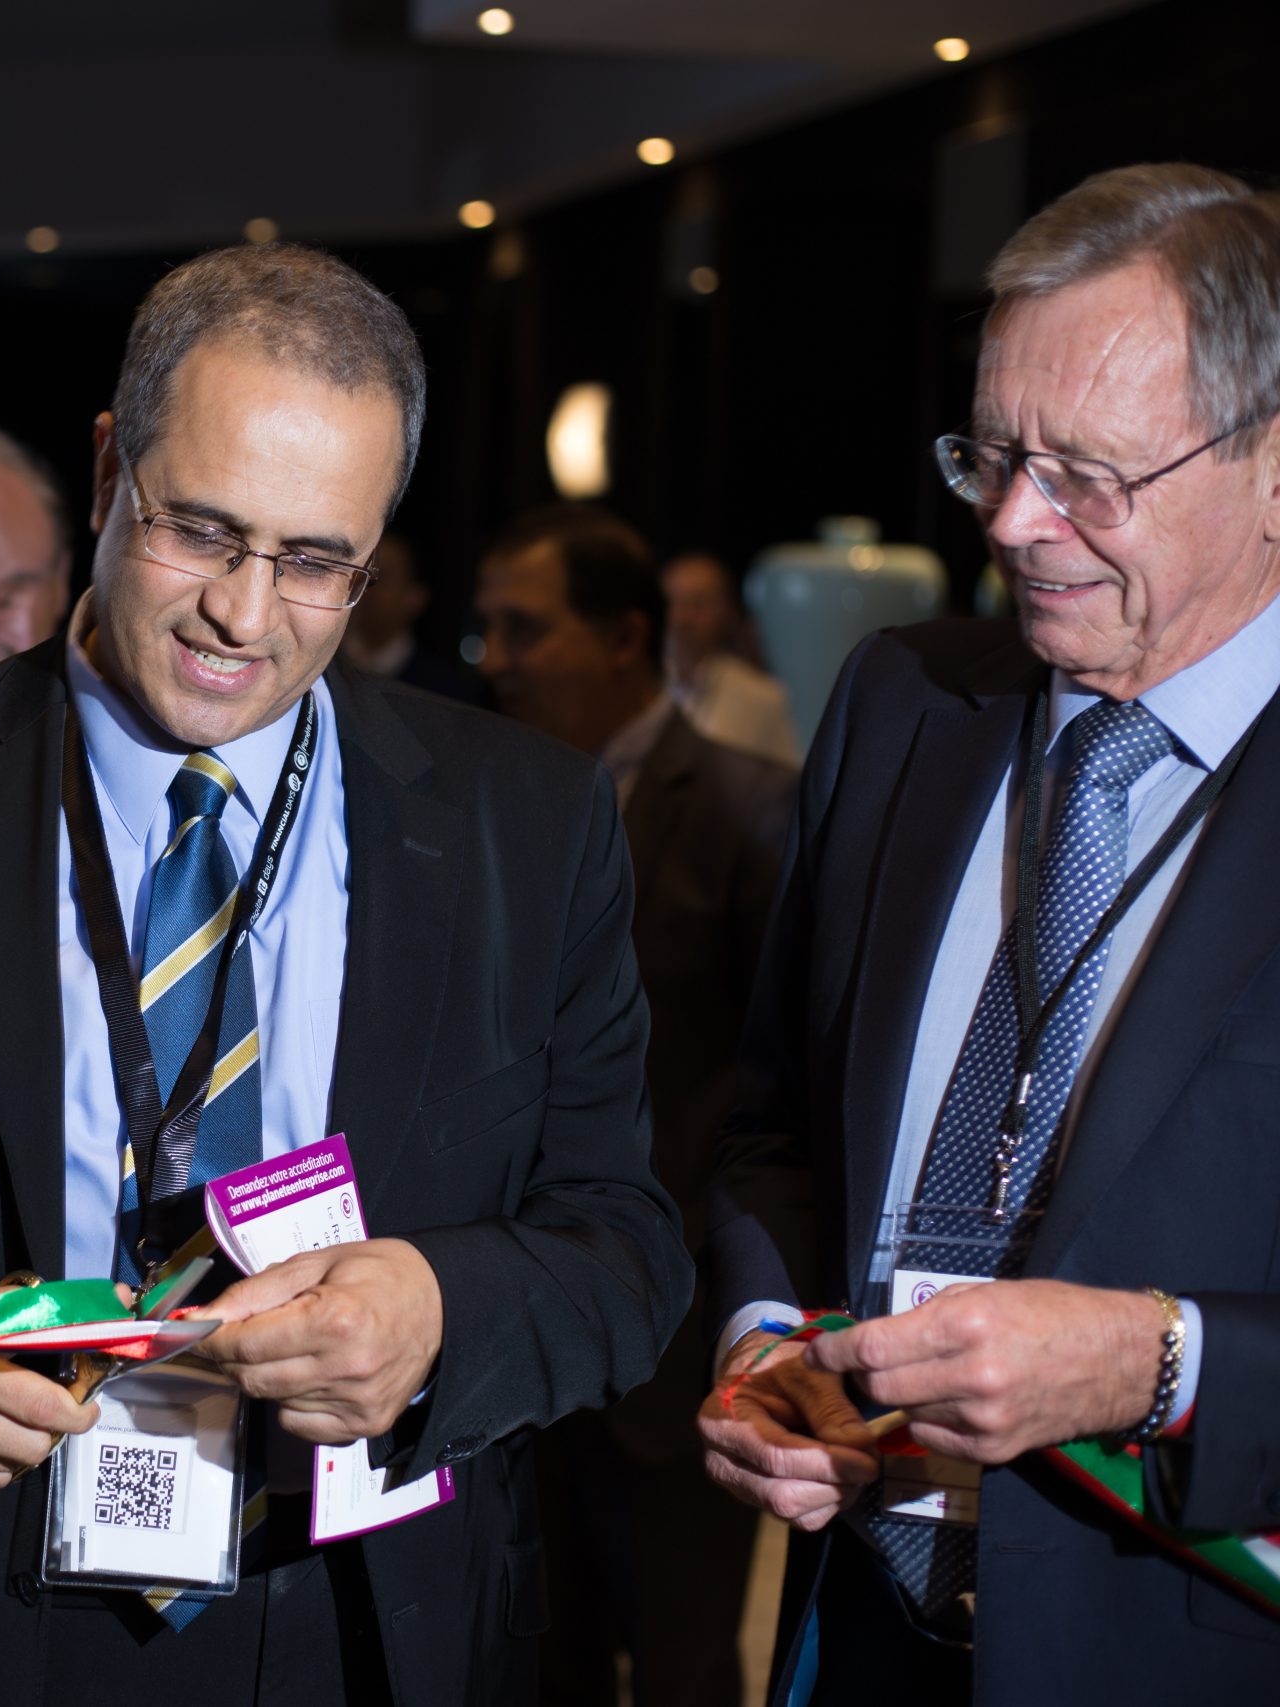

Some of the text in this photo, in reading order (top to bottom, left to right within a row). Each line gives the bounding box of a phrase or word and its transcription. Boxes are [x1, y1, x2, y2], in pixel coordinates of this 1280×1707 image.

[271, 790, 296, 851] FINANCIAL DAYS
[249, 897, 264, 926] Digital
[263, 856, 273, 880] days
[227, 1152, 334, 1199] Demandez votre accréditation
[230, 1164, 345, 1217] sur www.planeteentreprise.com
